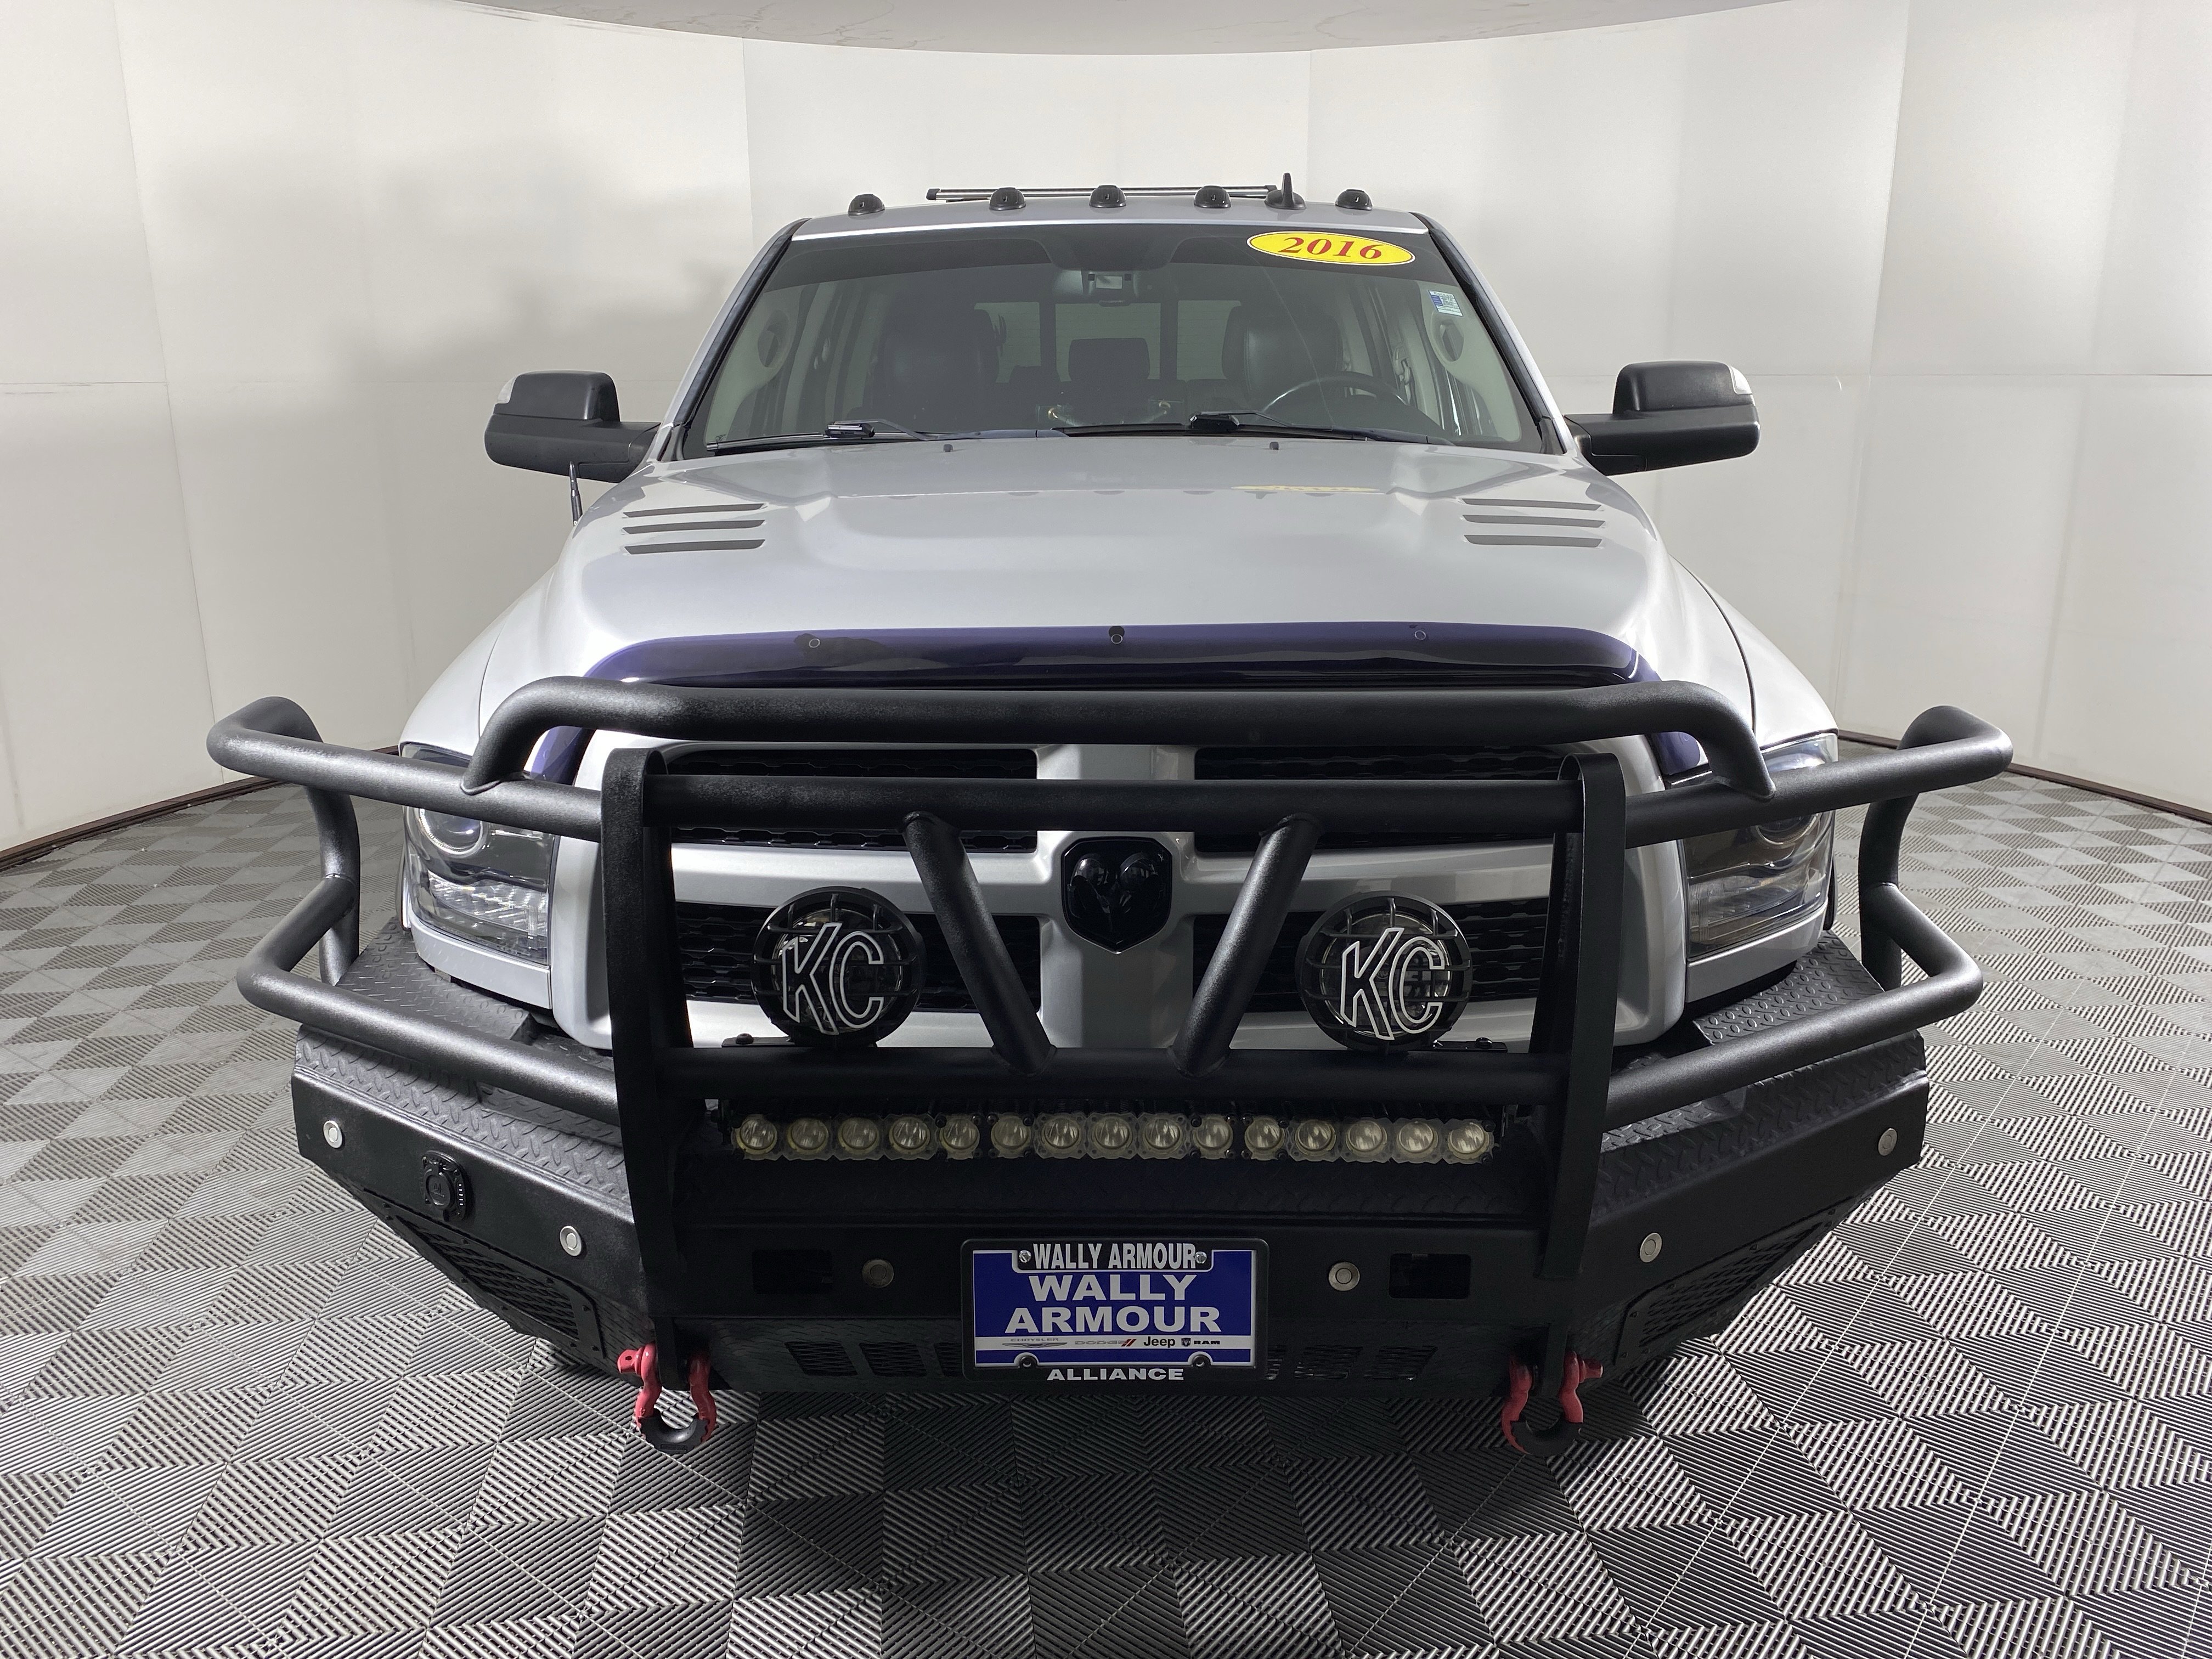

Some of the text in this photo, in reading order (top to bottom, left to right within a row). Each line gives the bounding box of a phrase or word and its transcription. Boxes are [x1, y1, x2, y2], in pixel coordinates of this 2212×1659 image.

[1278, 237, 1385, 259] 2016
[782, 922, 884, 1035] KC
[1340, 927, 1445, 1040] KC
[1033, 1243, 1196, 1269] WALLY ARMOUR
[1028, 1274, 1197, 1301] WALLY
[1005, 1306, 1222, 1333] ARMOUR
[1143, 1336, 1176, 1348] Jeep
[1047, 1368, 1184, 1380] ALLIANCE
